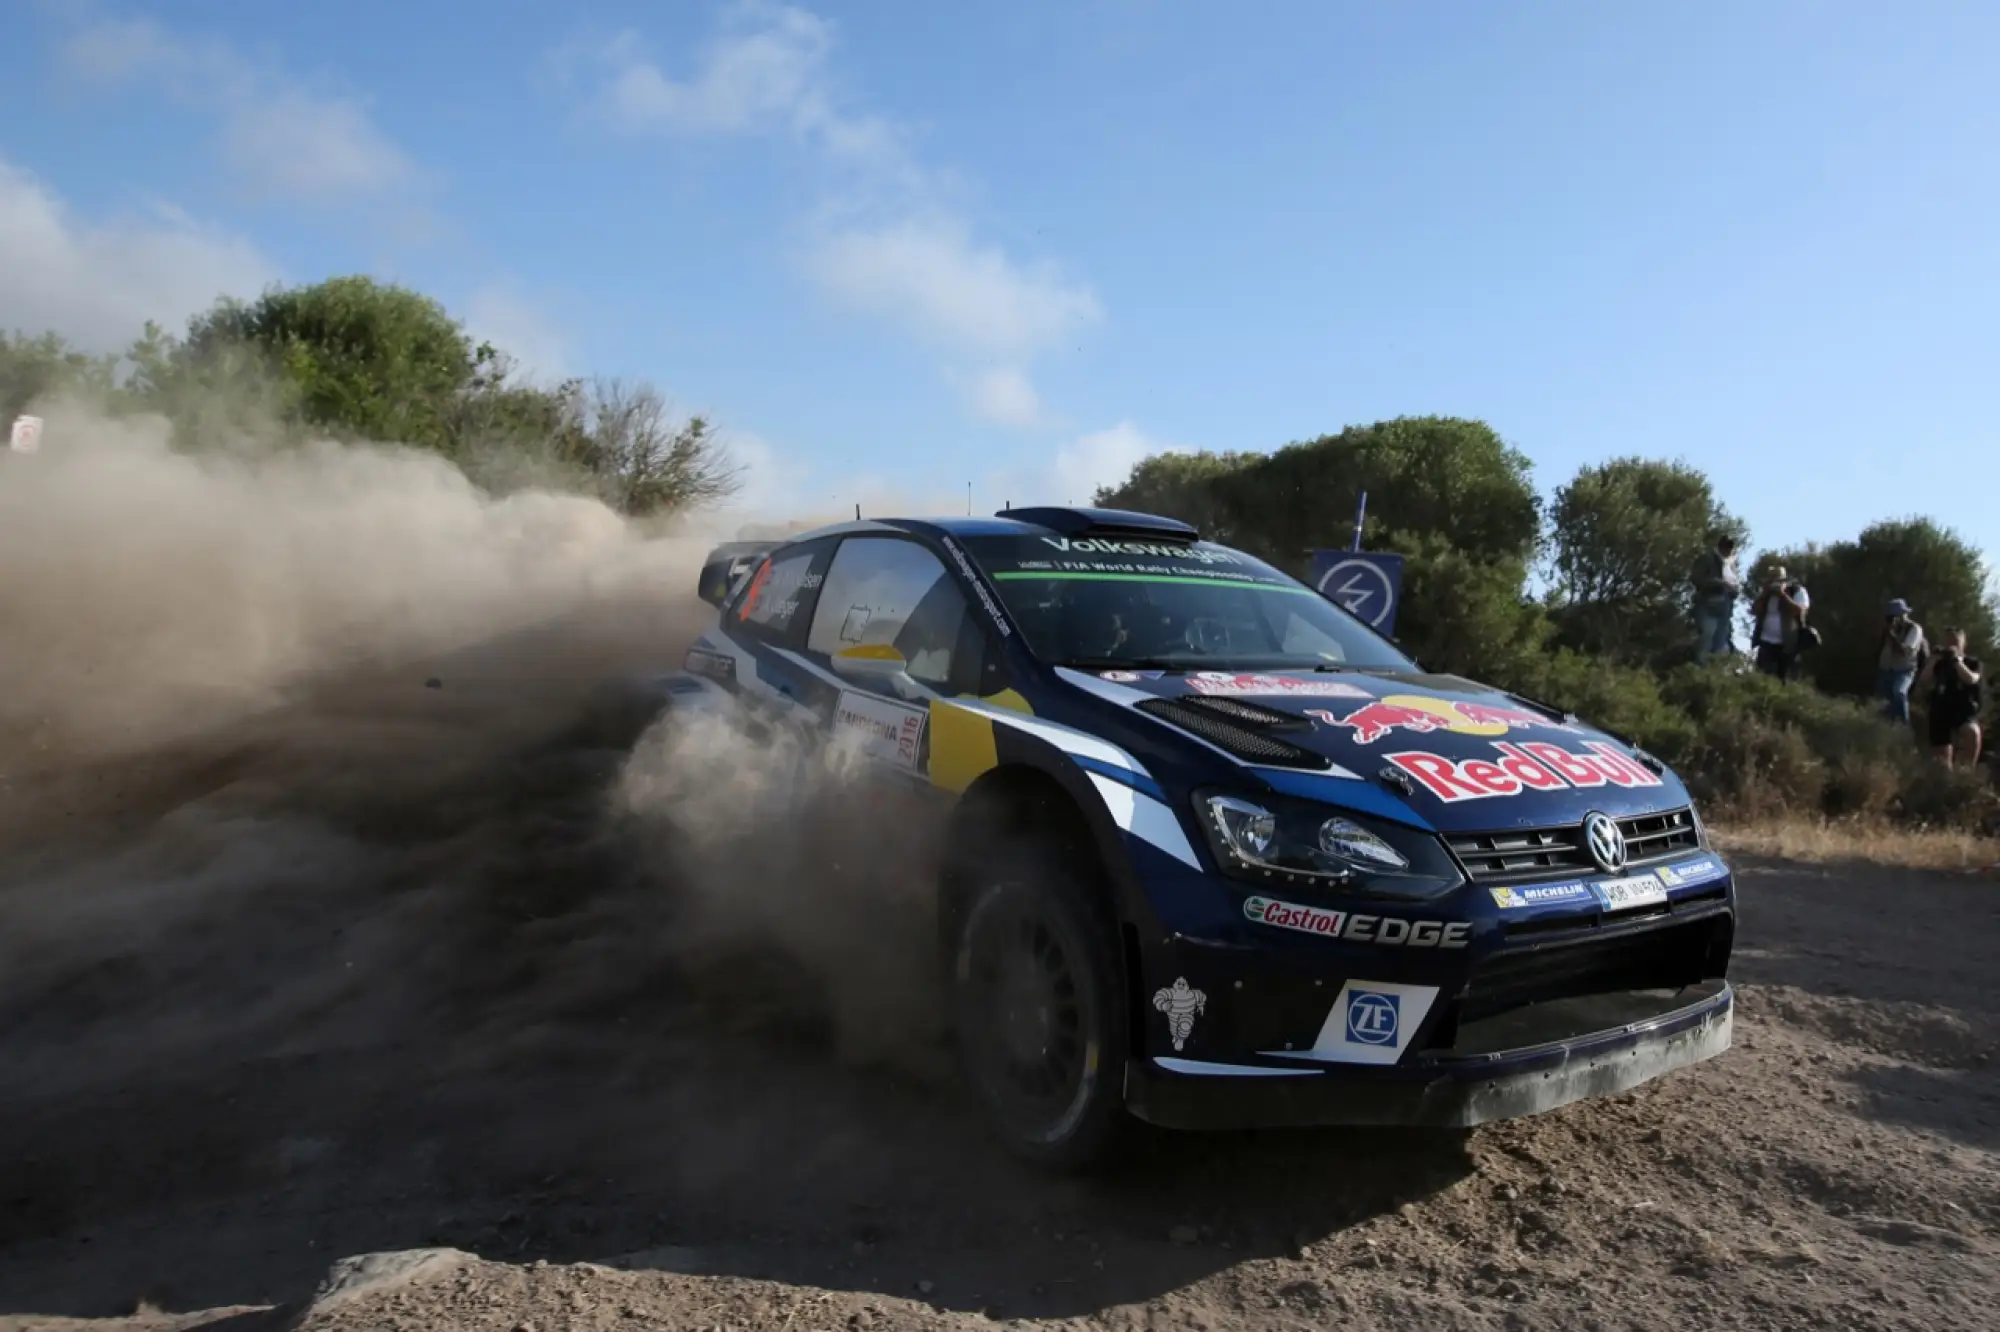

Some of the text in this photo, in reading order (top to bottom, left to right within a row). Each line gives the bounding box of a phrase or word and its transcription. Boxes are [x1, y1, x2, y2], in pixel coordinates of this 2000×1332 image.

[1040, 536, 1243, 566] Volkswagen
[1063, 561, 1090, 571] FIA
[1092, 562, 1134, 572] World
[1524, 883, 1585, 900] MICHELIN
[1263, 901, 1341, 933] Castrol
[1342, 914, 1474, 949] EDGE
[1352, 1001, 1395, 1036] ZF
